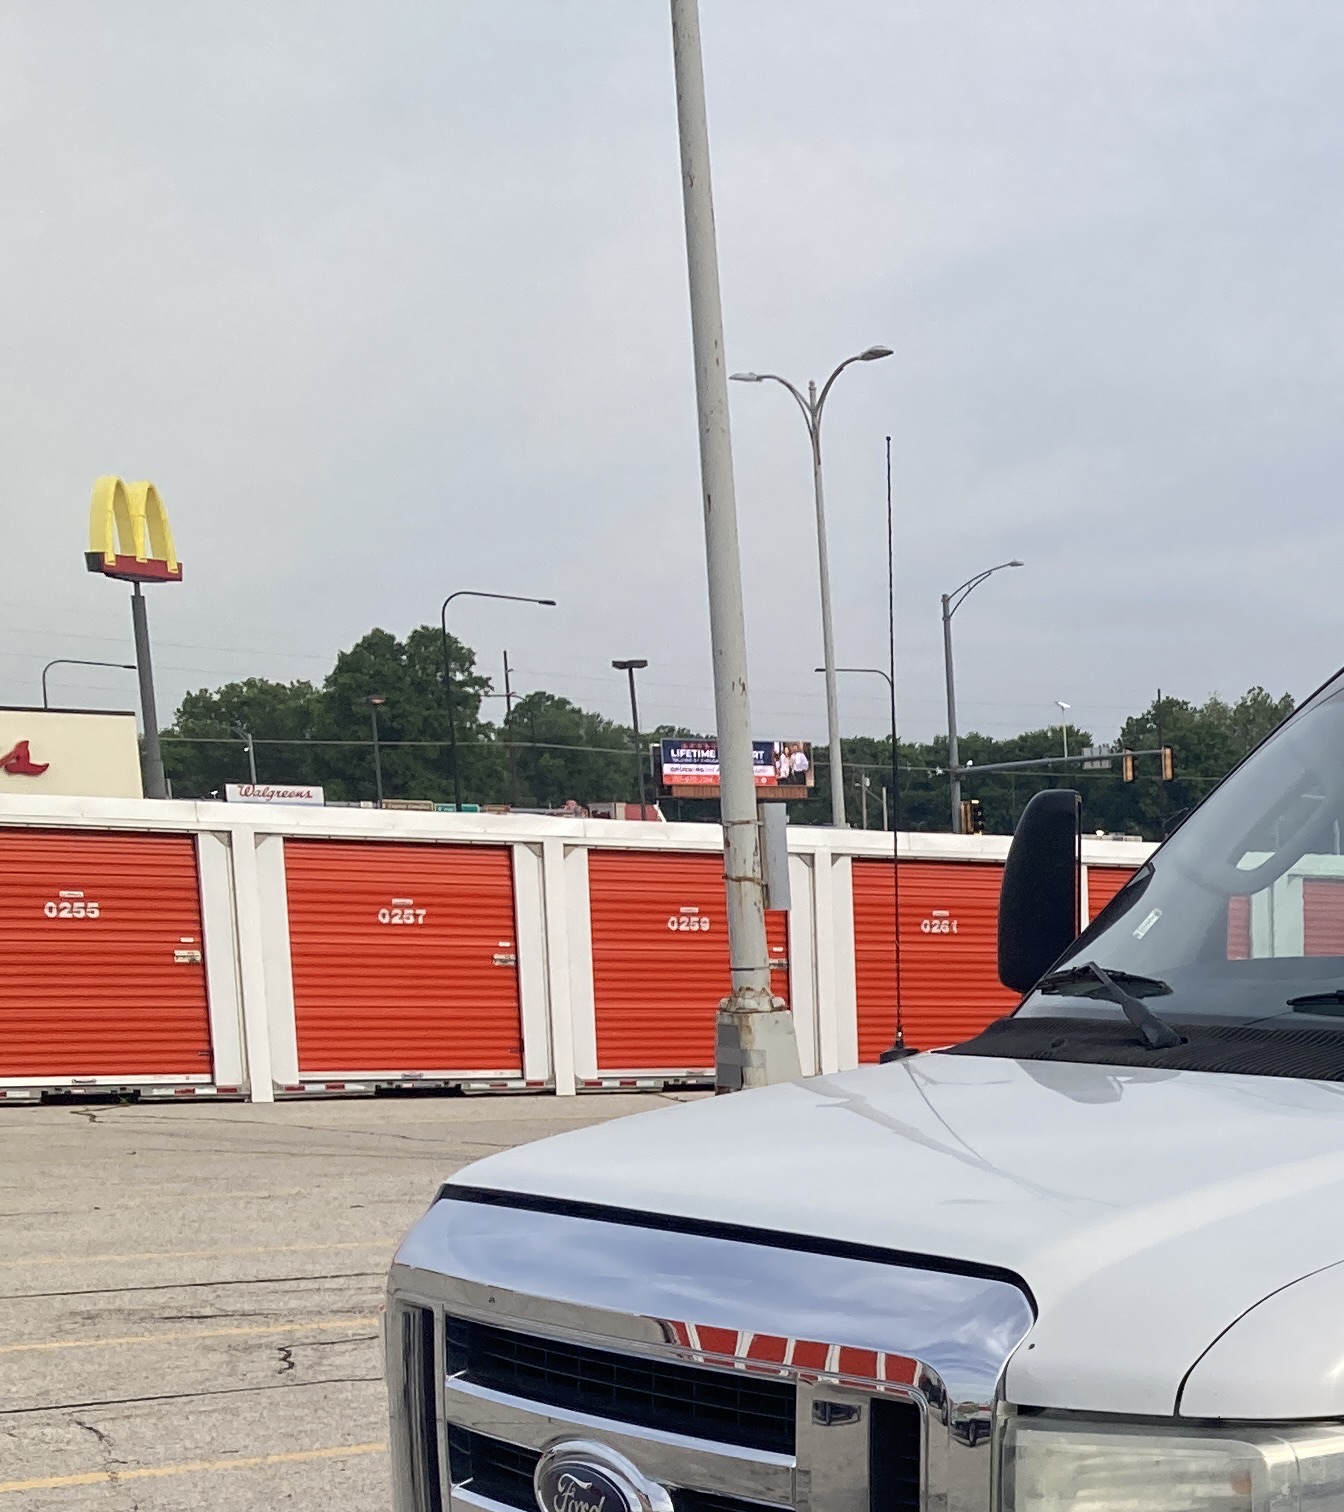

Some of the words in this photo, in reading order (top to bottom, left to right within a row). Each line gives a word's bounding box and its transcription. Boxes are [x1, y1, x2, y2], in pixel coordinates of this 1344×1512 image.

[670, 748, 717, 759] LIFETIME
[237, 784, 314, 802] Walgreens
[43, 901, 101, 919] 0255
[377, 907, 428, 925] 0257
